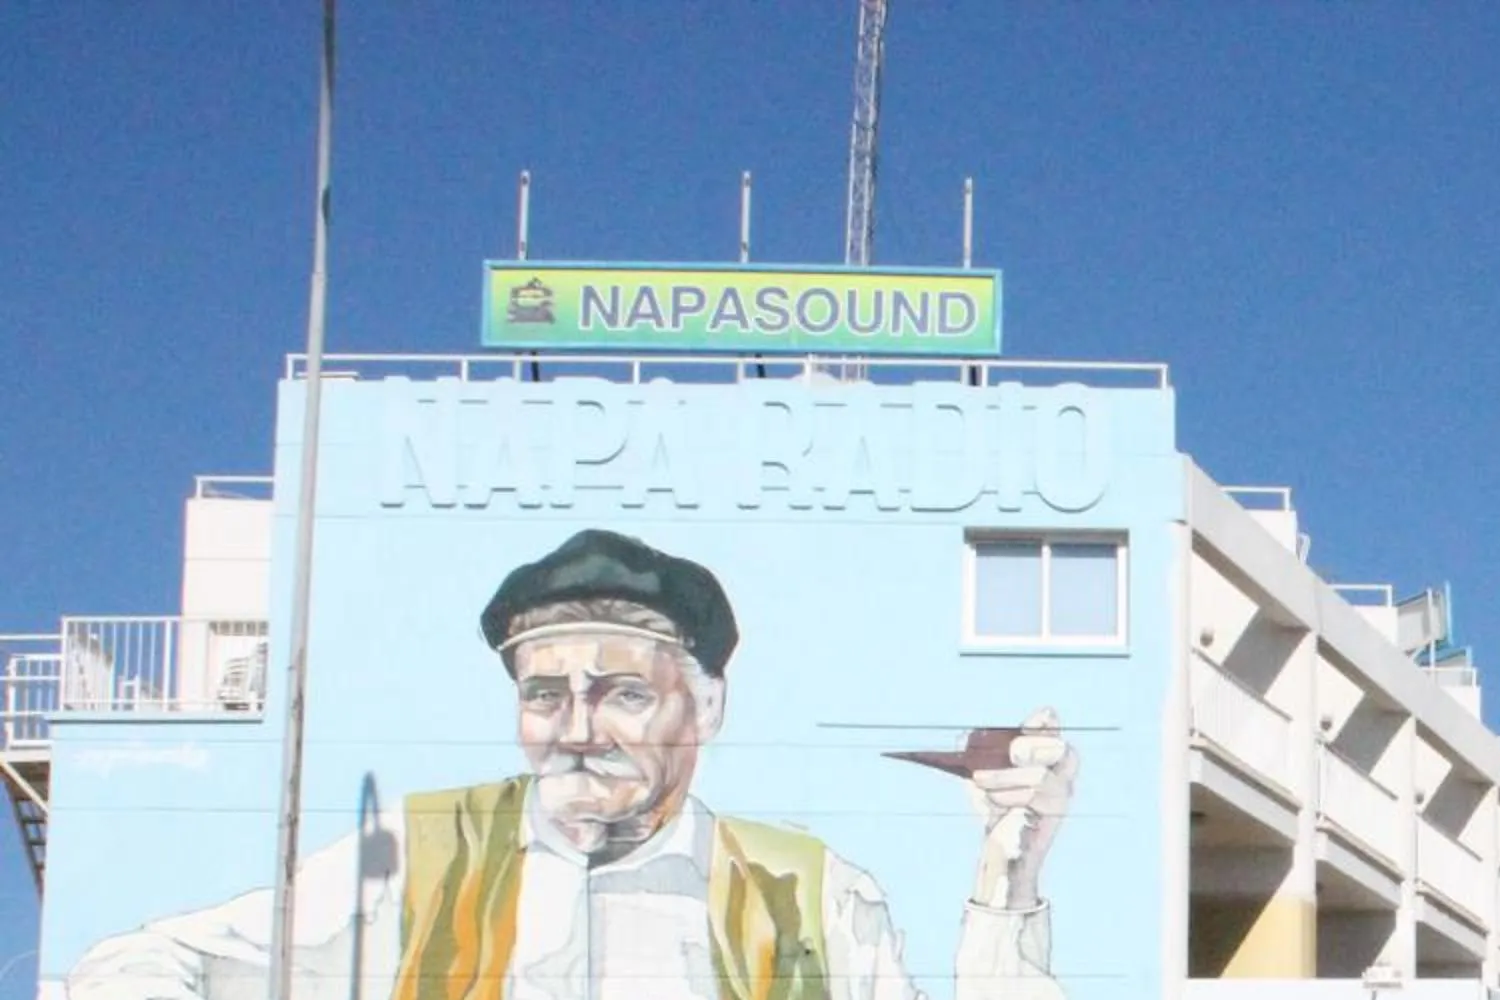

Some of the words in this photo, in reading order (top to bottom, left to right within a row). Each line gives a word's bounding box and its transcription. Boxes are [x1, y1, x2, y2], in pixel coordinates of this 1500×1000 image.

[580, 284, 978, 337] NAPASOUND
[381, 375, 700, 509] NAPA
[737, 376, 1110, 512] RADIO
